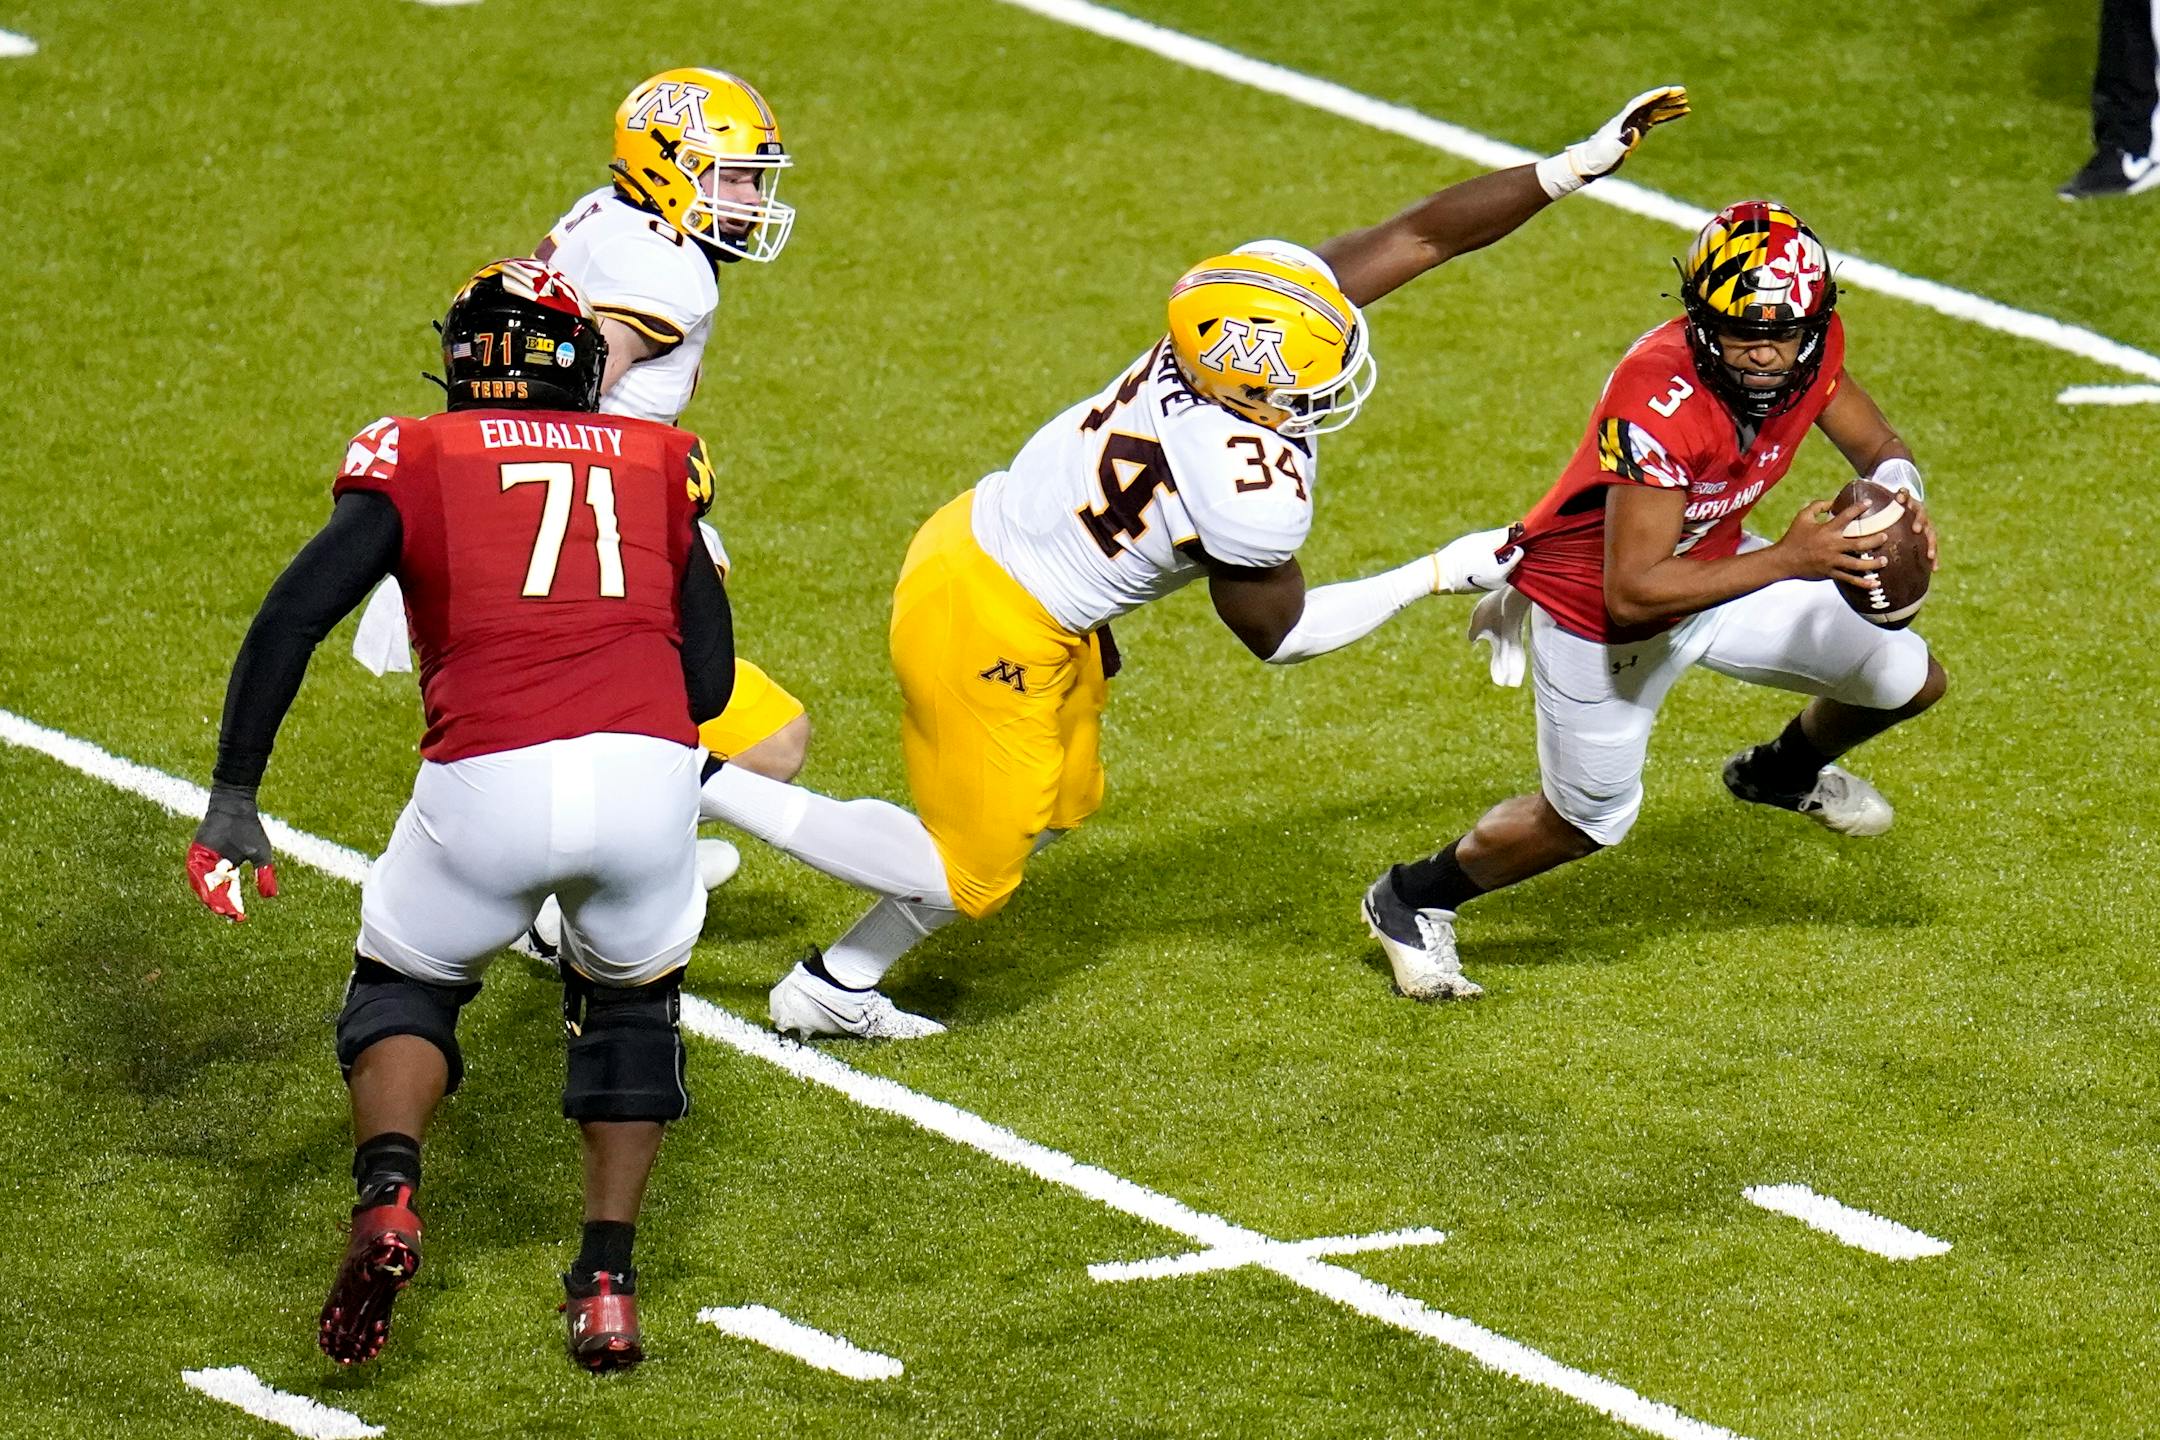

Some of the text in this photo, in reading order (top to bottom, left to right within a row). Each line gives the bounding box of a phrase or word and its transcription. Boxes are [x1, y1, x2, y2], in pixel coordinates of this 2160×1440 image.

[627, 82, 710, 145] M
[1761, 305, 1777, 320] M
[478, 332, 511, 367] 71
[1199, 318, 1297, 385] M
[470, 380, 530, 400] TERPS
[1647, 374, 1695, 419] 3
[479, 418, 623, 458] EQUALITY
[1226, 435, 1308, 502] 34
[1684, 479, 1765, 521] ARYLAND
[499, 460, 628, 599] 71
[978, 656, 1030, 694] M
